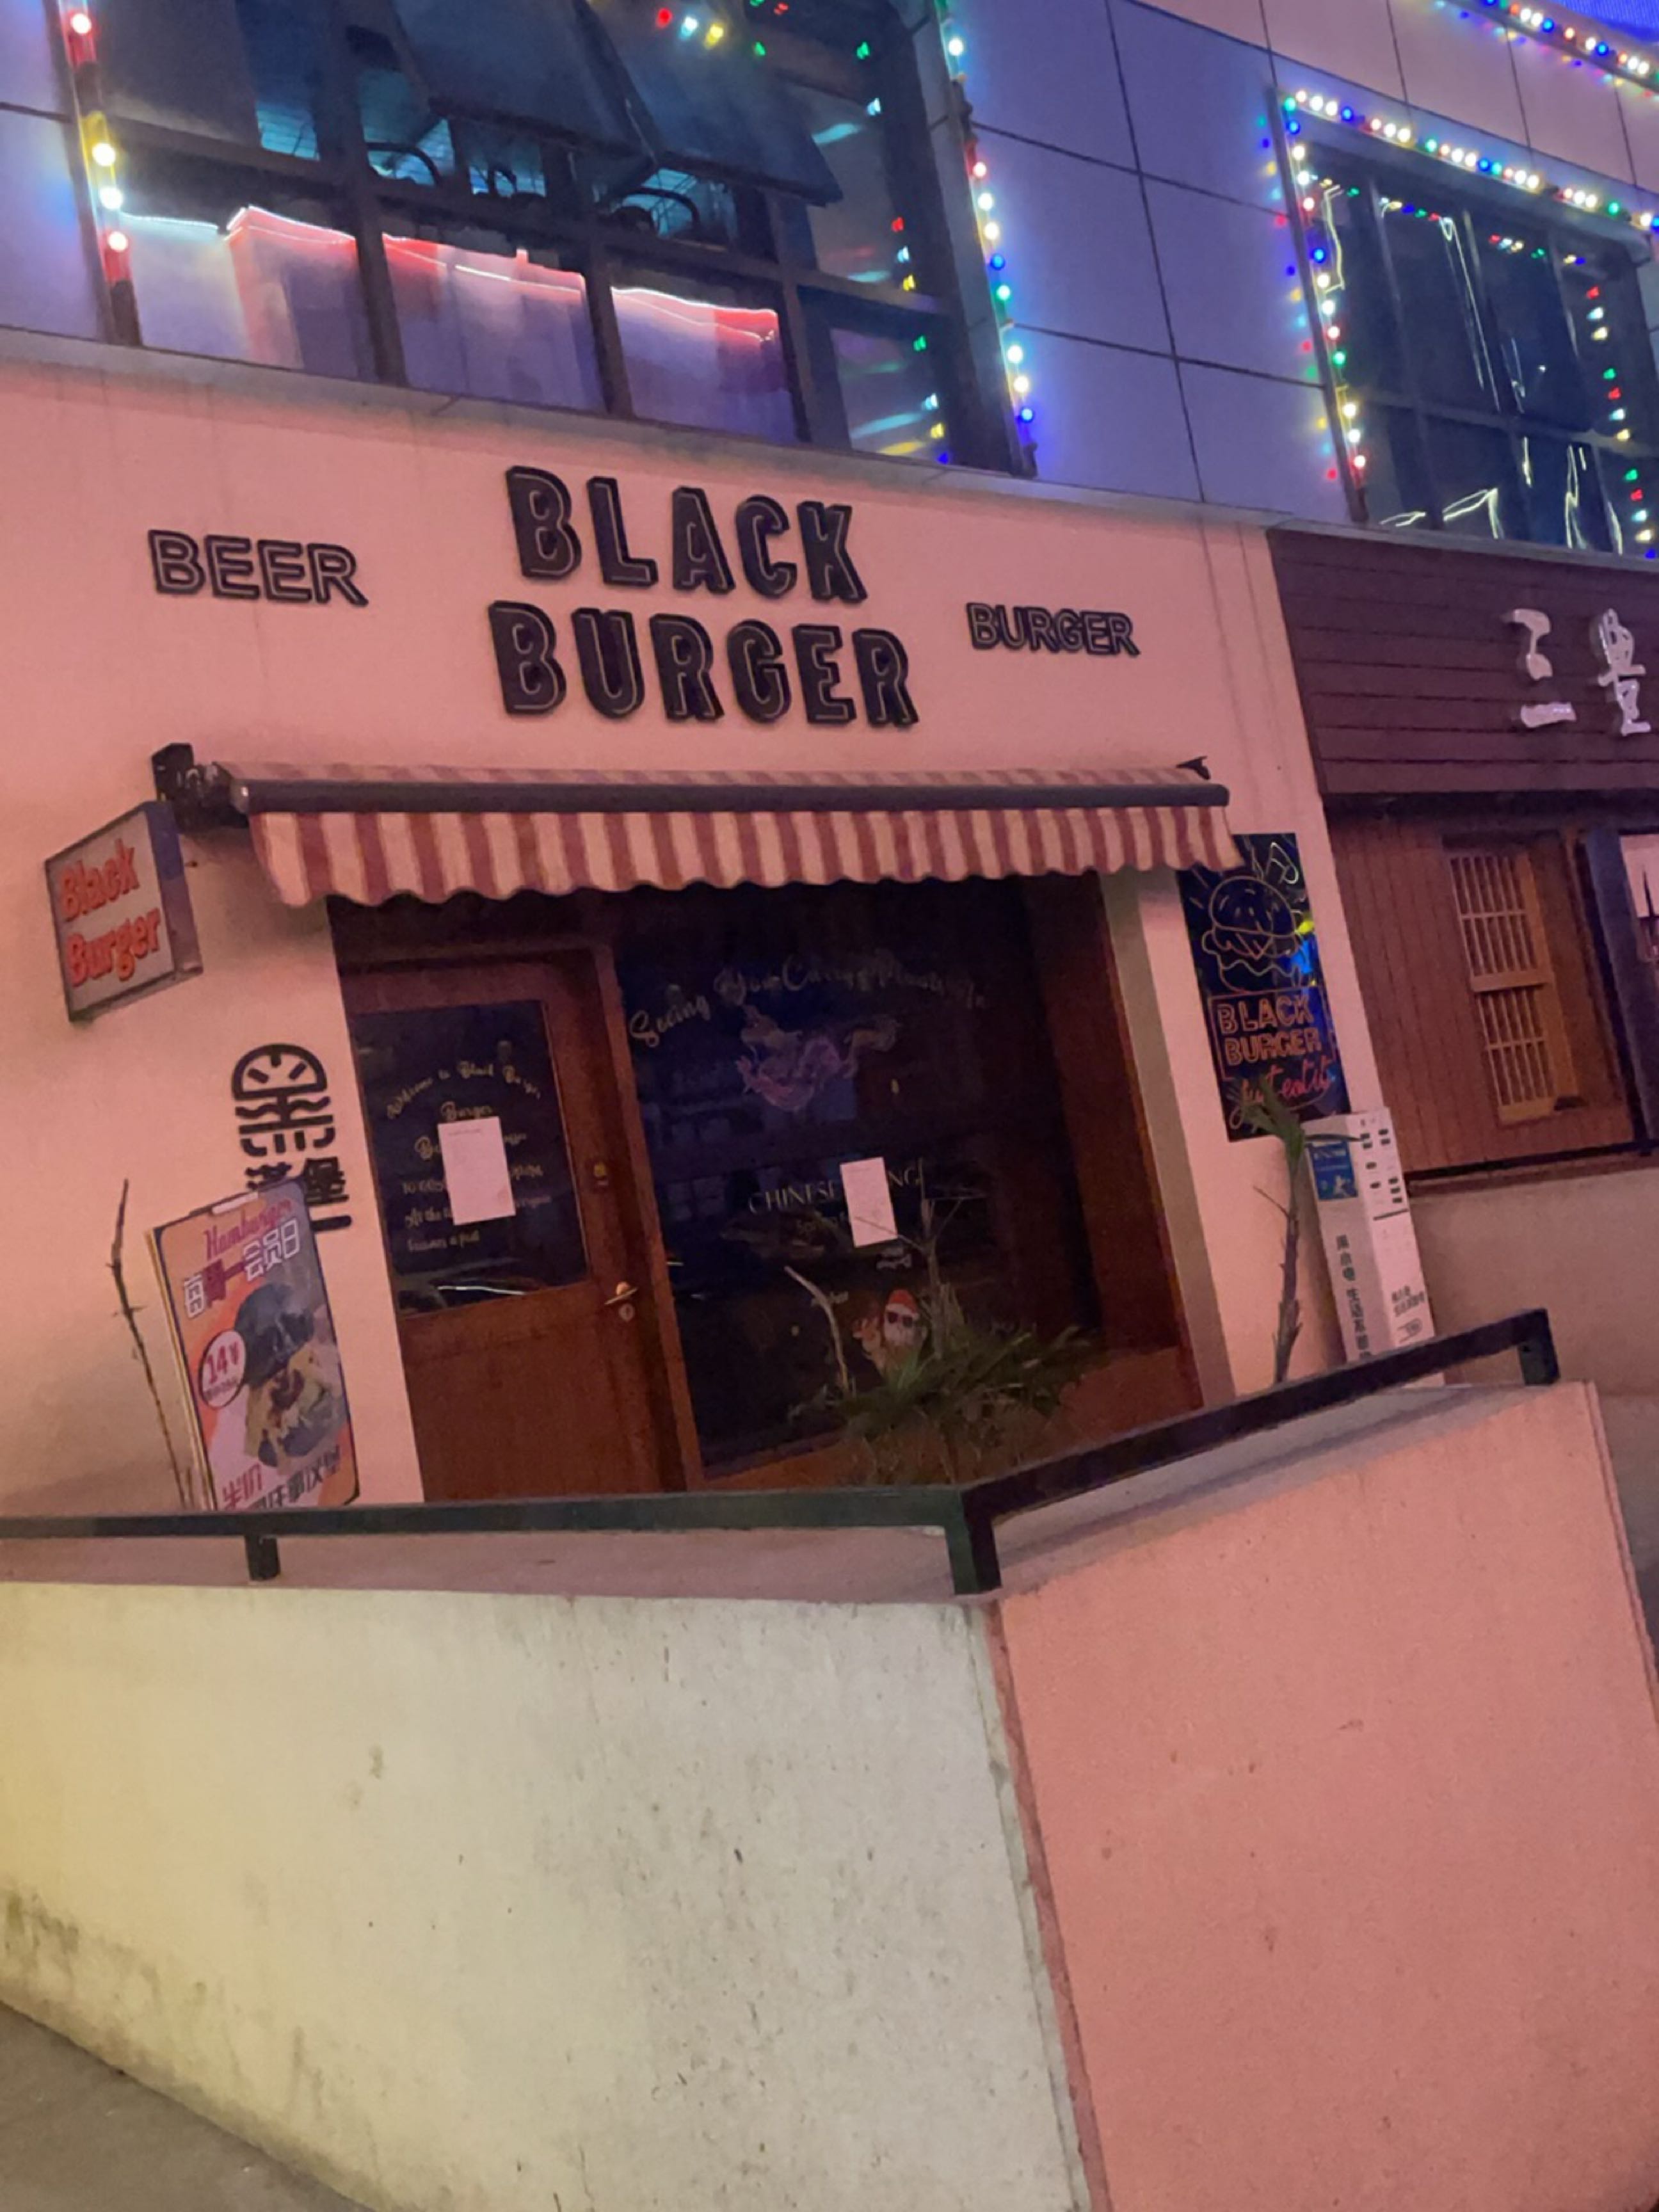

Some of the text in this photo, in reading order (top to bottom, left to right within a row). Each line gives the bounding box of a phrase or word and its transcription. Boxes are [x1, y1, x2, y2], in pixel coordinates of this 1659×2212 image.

[148, 529, 369, 607] BEER
[505, 465, 869, 605] BLACK
[488, 600, 920, 728] BURGER
[966, 602, 1141, 657] BURGER
[59, 837, 140, 922] Black
[67, 907, 160, 988] Burger
[1217, 994, 1315, 1034] BLACK
[1224, 1027, 1322, 1066] BURGER
[1229, 1062, 1284, 1130] Jut
